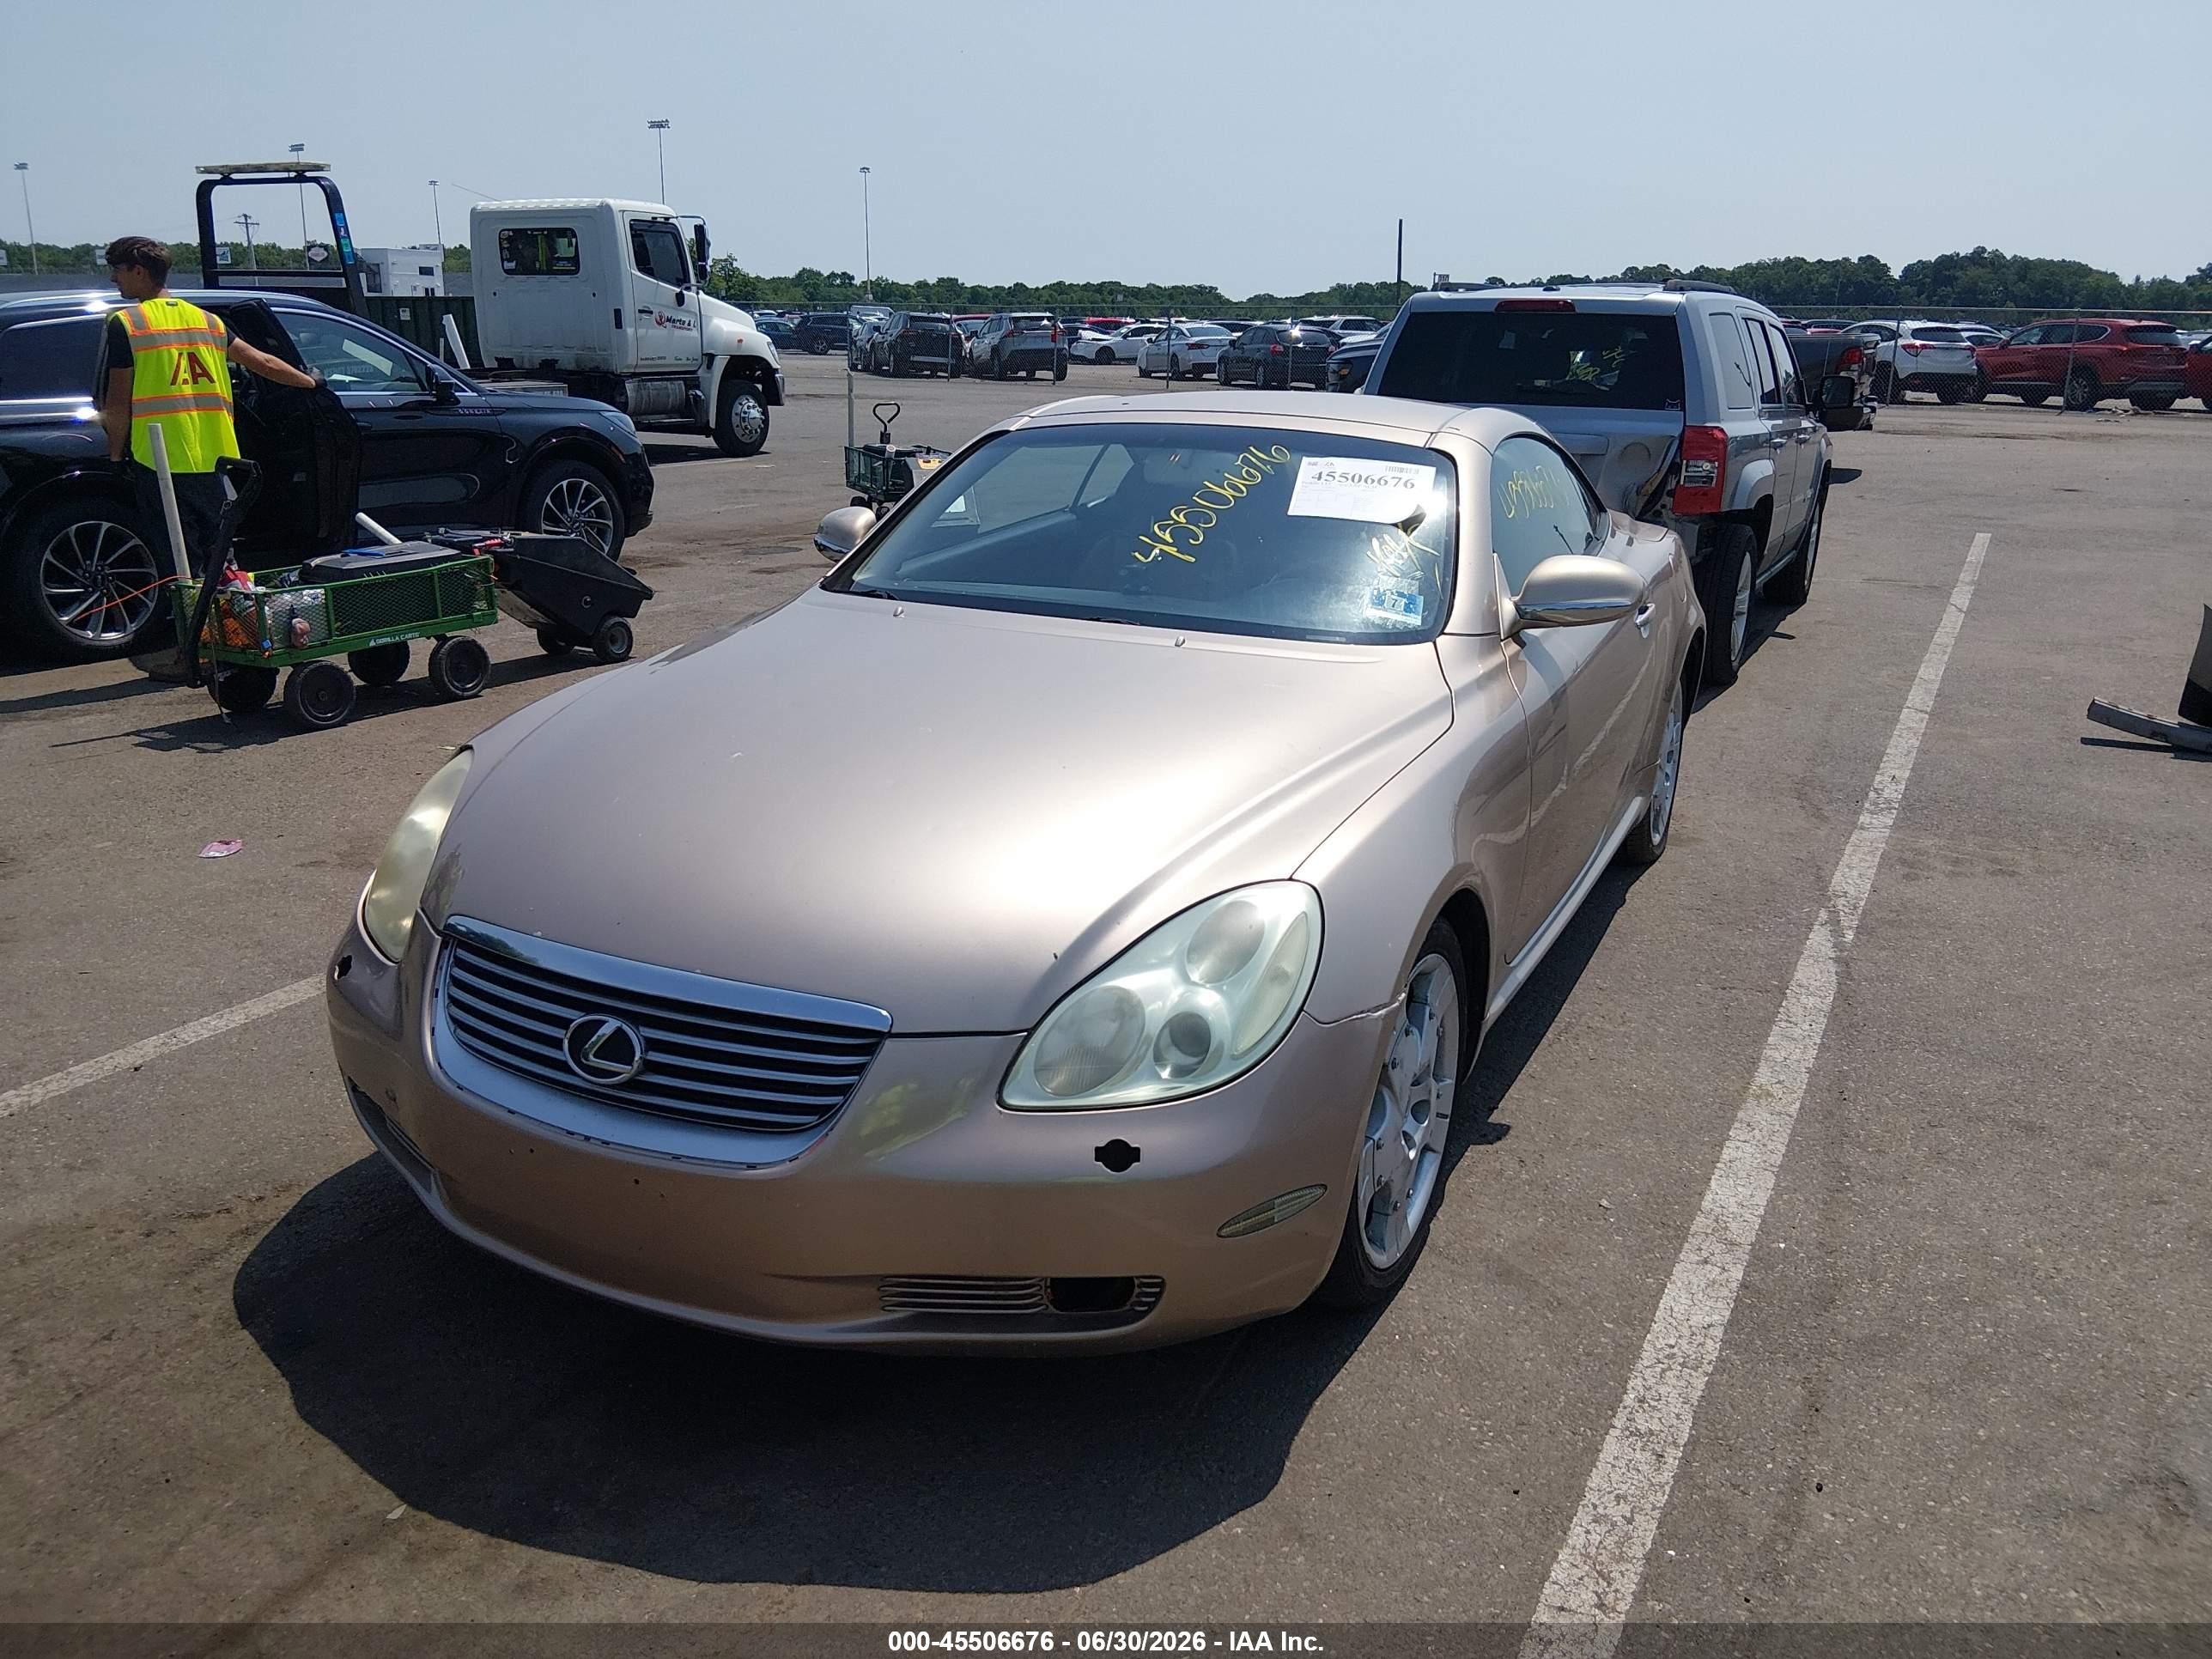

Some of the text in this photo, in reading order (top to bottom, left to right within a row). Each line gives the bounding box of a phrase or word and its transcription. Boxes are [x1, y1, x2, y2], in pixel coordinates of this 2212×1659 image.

[1311, 471, 1416, 489] 45506676
[1131, 444, 1291, 563] 45506676
[1390, 598, 1398, 608] 7
[375, 635, 400, 644] GORILLA
